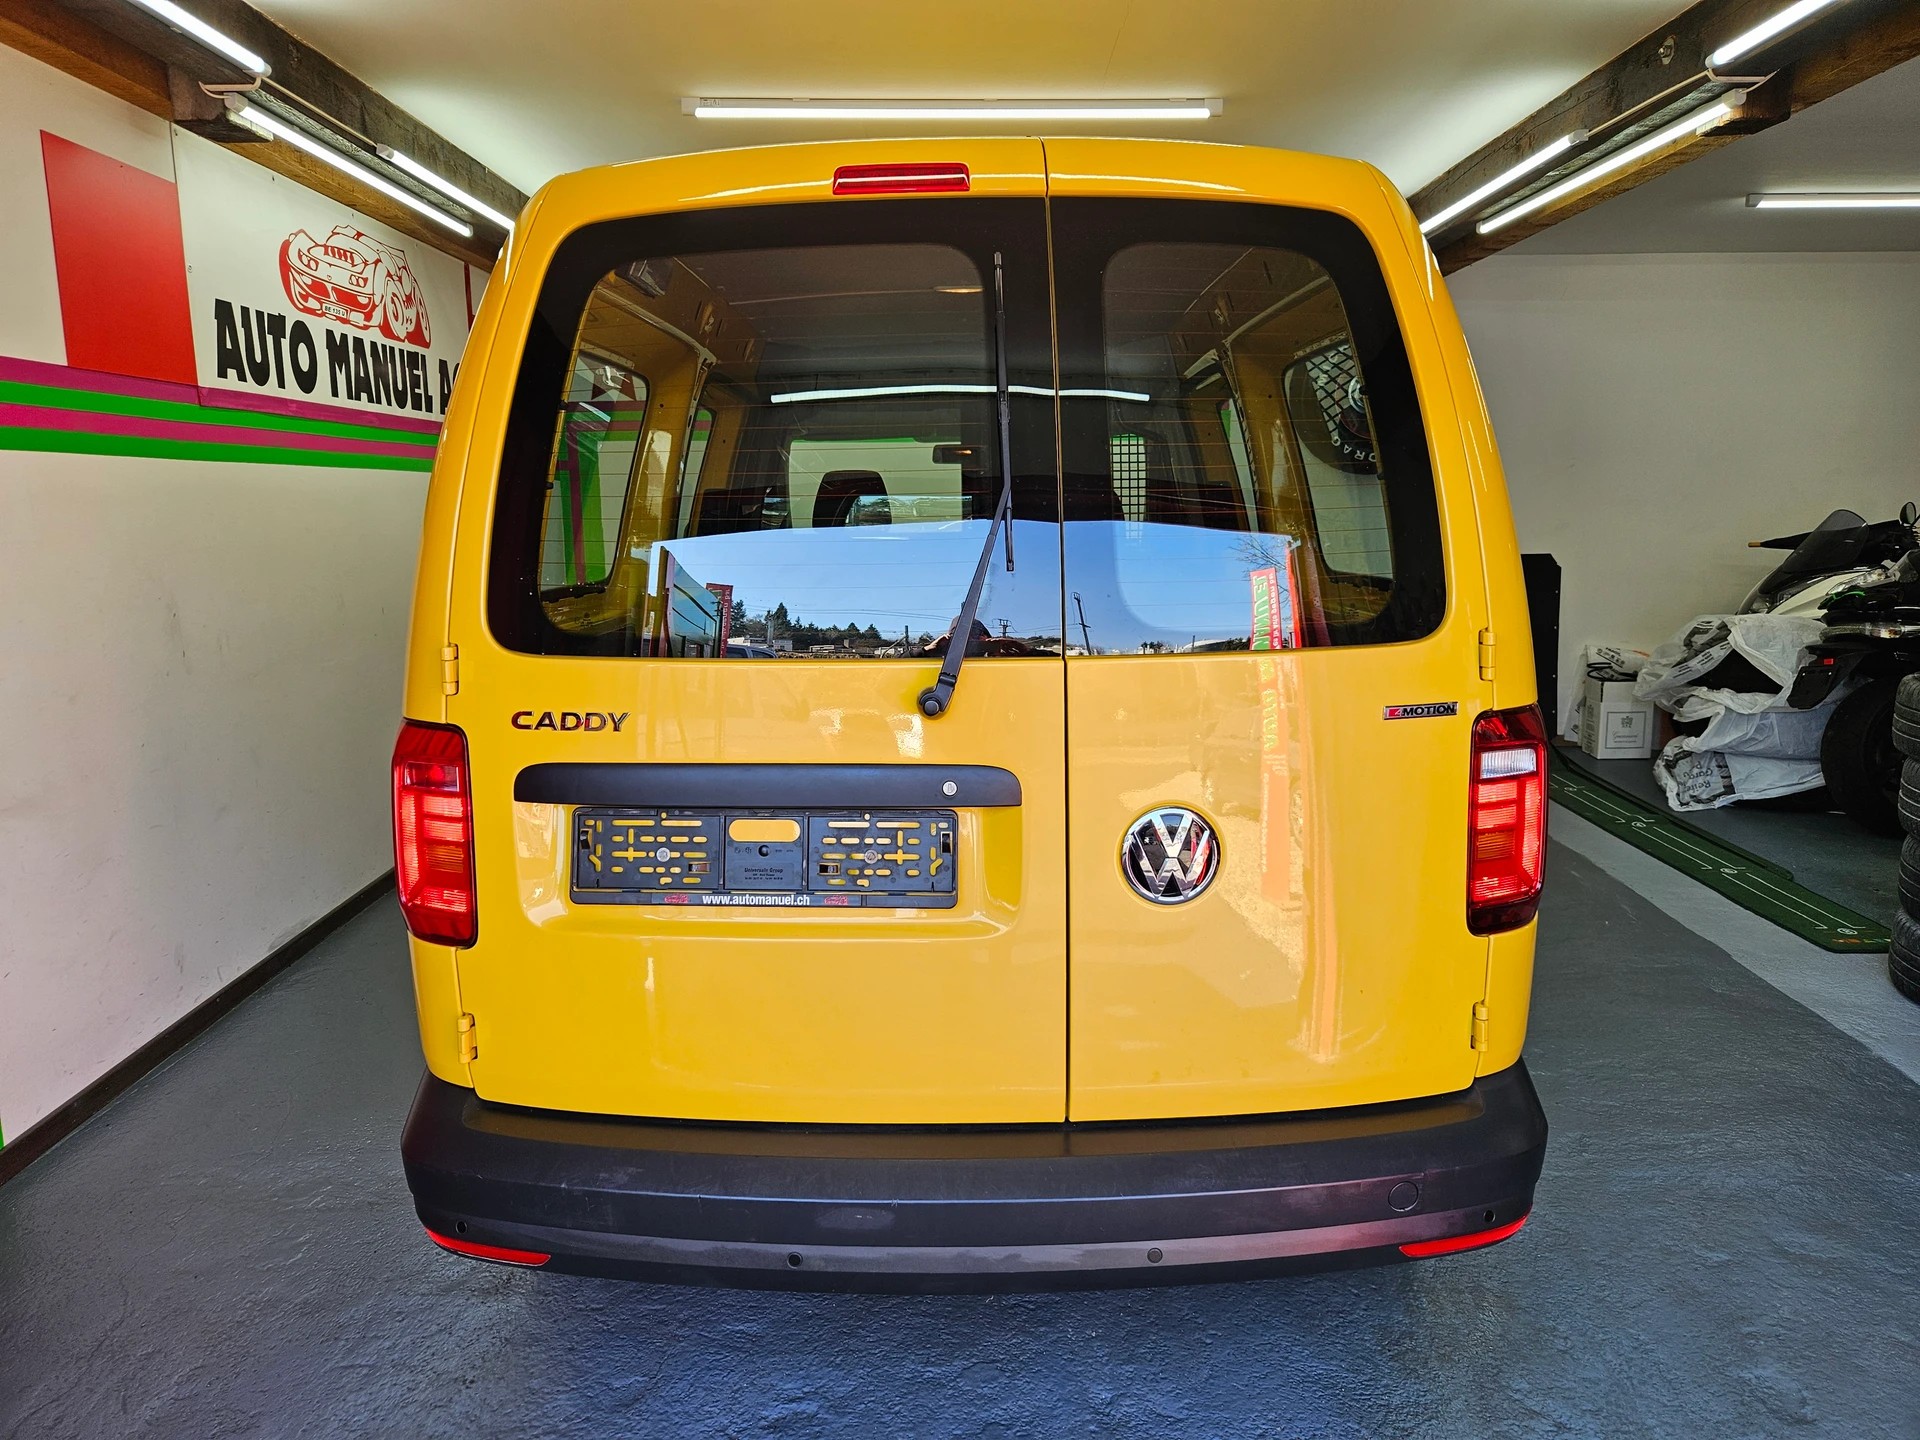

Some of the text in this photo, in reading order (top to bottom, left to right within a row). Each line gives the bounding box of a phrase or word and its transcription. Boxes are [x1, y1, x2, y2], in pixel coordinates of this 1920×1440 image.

[214, 298, 318, 394] AUTO
[325, 328, 434, 414] MANUEL
[511, 711, 630, 732] CADDY
[702, 894, 810, 905] www.automanuel.ch
